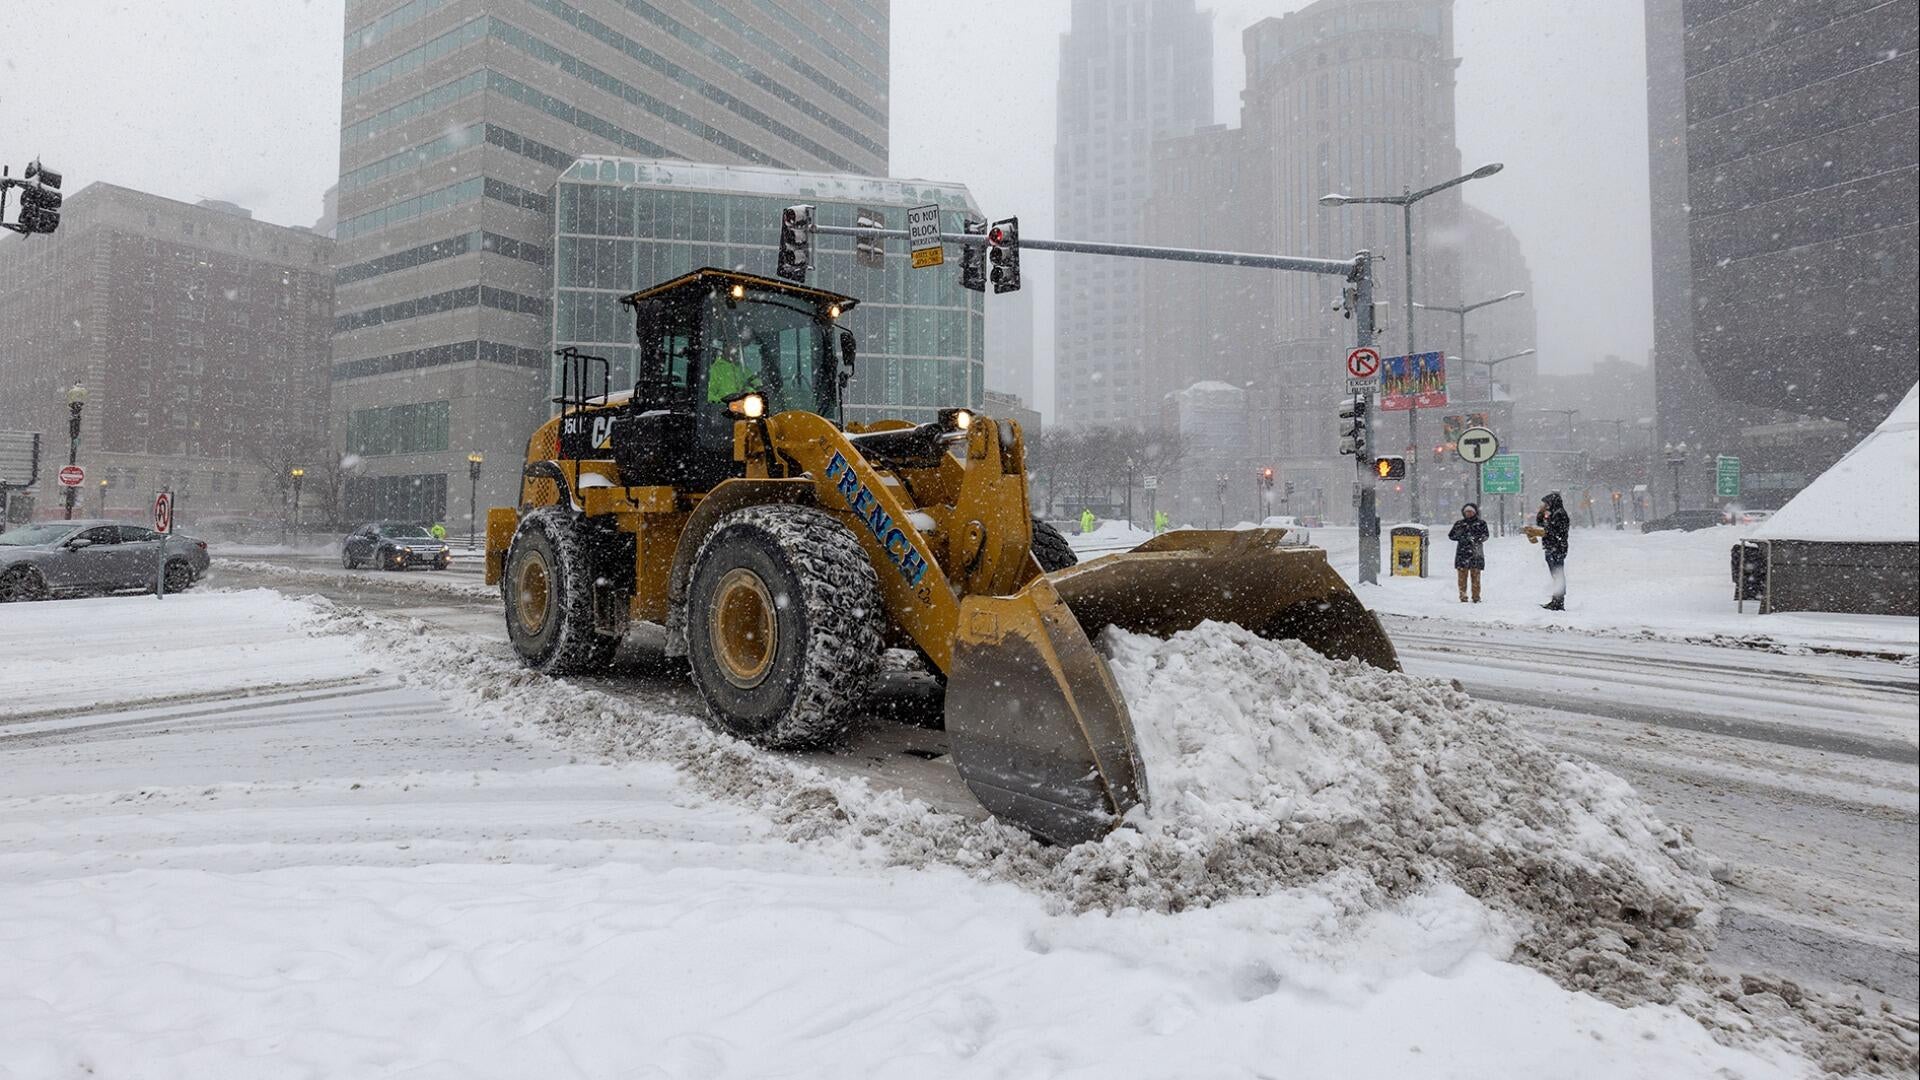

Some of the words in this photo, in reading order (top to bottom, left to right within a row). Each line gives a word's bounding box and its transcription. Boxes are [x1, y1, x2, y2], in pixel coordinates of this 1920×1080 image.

[909, 213, 920, 224] DO
[922, 210, 937, 221] NOT
[912, 225, 938, 237] BLOCK
[1350, 379, 1377, 387] EXCEPT
[591, 416, 617, 449] CA
[1464, 437, 1490, 458] T
[825, 448, 928, 589] FRENCH
